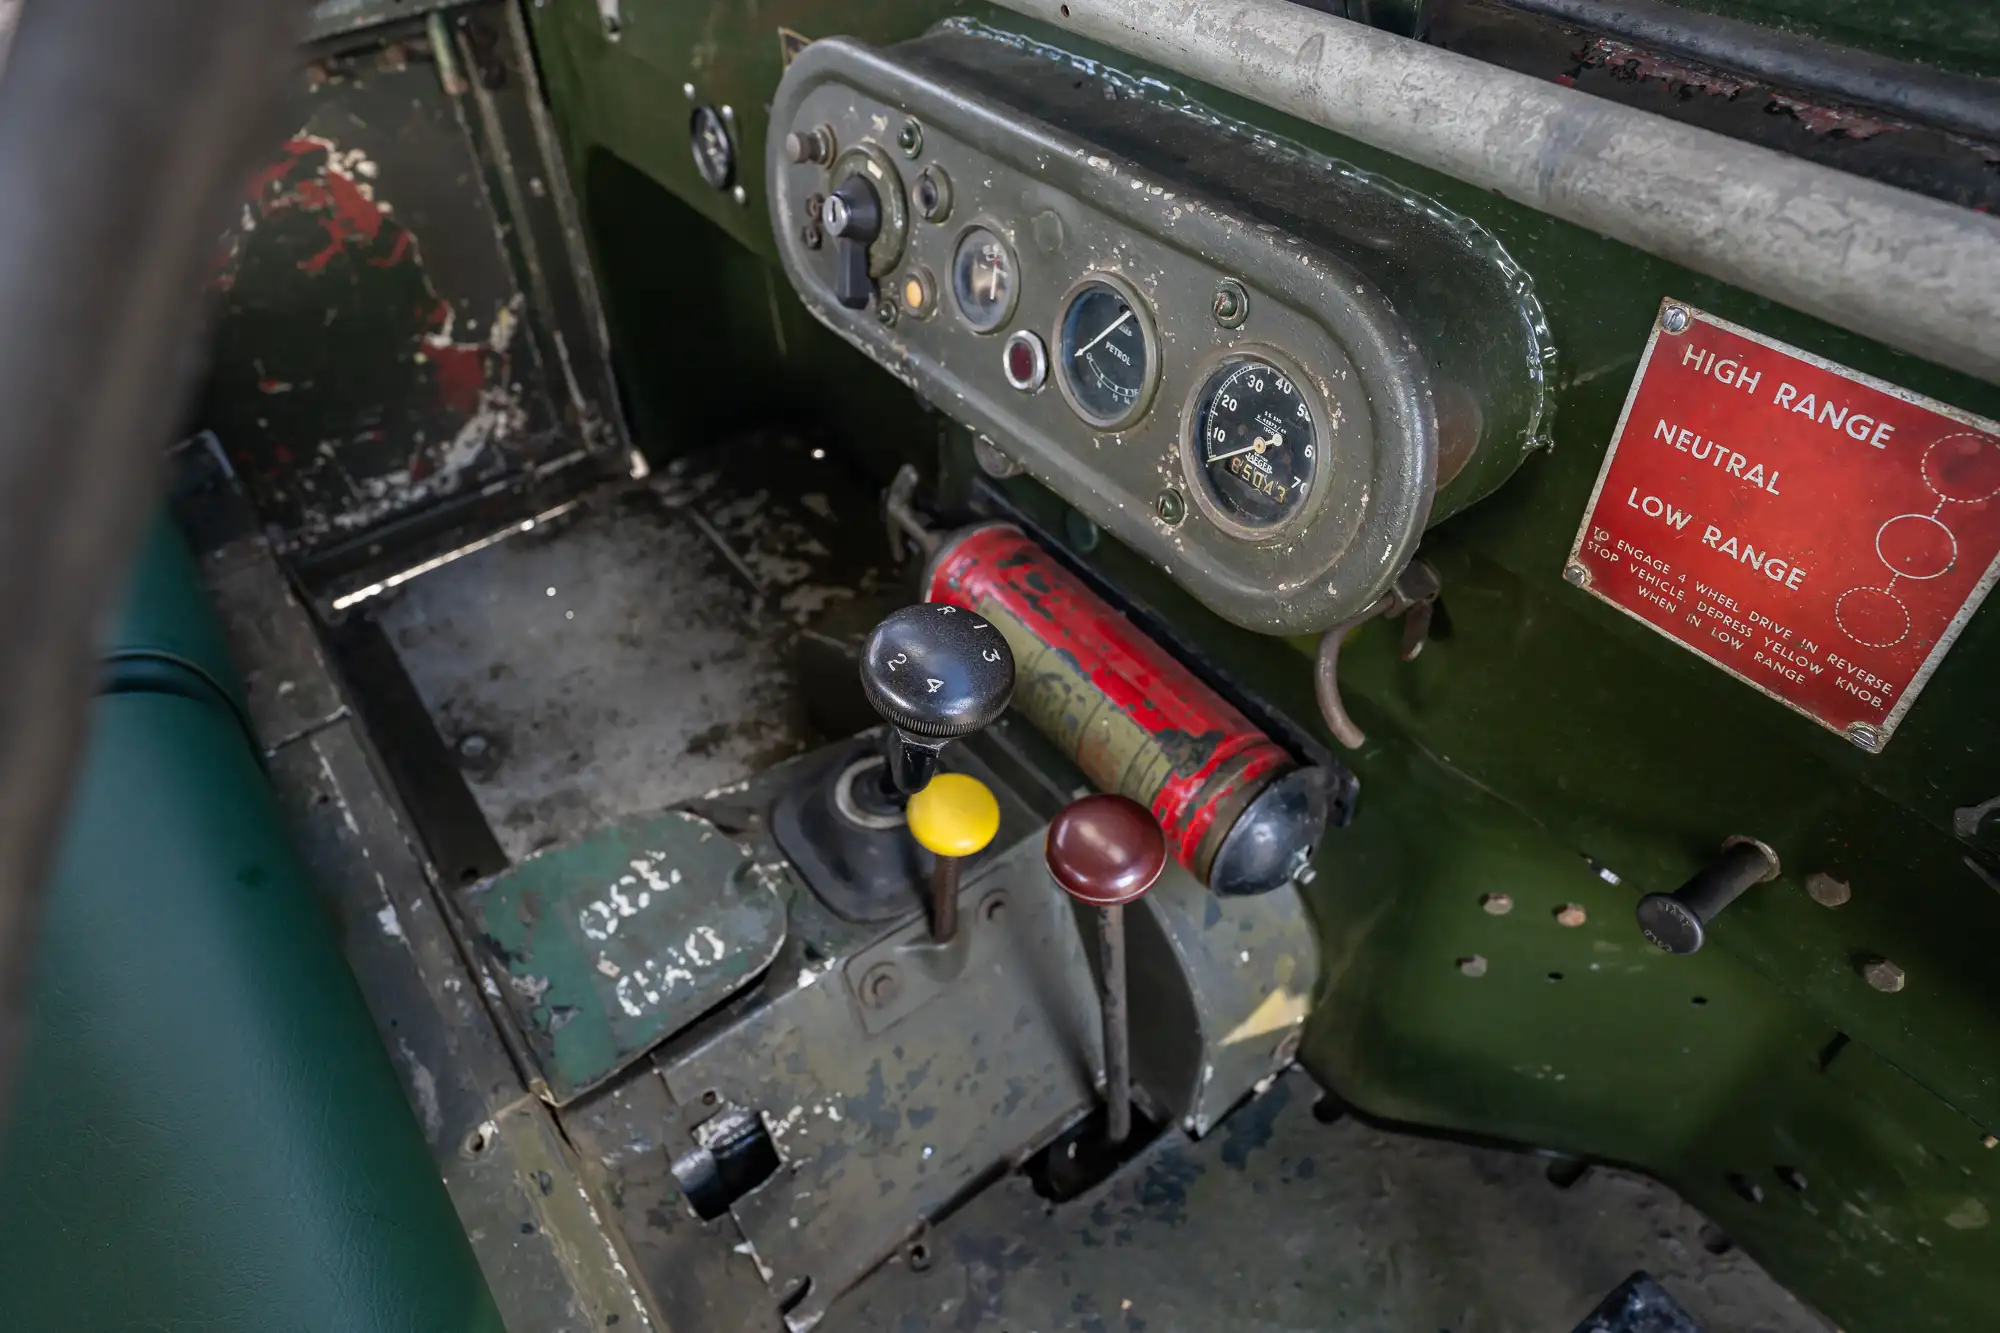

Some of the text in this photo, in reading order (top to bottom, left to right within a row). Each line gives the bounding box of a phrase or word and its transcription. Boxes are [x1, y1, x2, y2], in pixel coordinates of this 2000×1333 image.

[1104, 341, 1131, 366] PETROL
[1247, 374, 1264, 393] 30
[1275, 377, 1292, 395] 40
[1221, 394, 1238, 412] 20
[1682, 343, 1896, 450] HIGH RANGE
[1213, 426, 1226, 443] 10
[1304, 444, 1314, 459] 6
[1653, 418, 1780, 496] NEUTRAL
[1245, 452, 1273, 475] JAEGER
[1290, 476, 1309, 495] 70
[1627, 487, 1807, 591] LOW RANGE
[1593, 526, 1610, 543] TO
[1616, 539, 1671, 575] ENGAGE
[1677, 573, 1687, 584] 4
[1695, 580, 1740, 613] WHEEL
[1748, 611, 1793, 641] DRIVE
[1801, 638, 1819, 655] IN
[936, 605, 957, 615] R
[1587, 540, 1620, 563] STOP
[1697, 600, 1754, 638] DEPRESS
[1763, 636, 1824, 676] YELLOW
[1637, 585, 1677, 614] WHEN
[1686, 612, 1702, 628] IN
[1710, 626, 1744, 651] LOW
[886, 652, 908, 672] 2
[982, 648, 1001, 663] 3
[926, 678, 945, 693] 4
